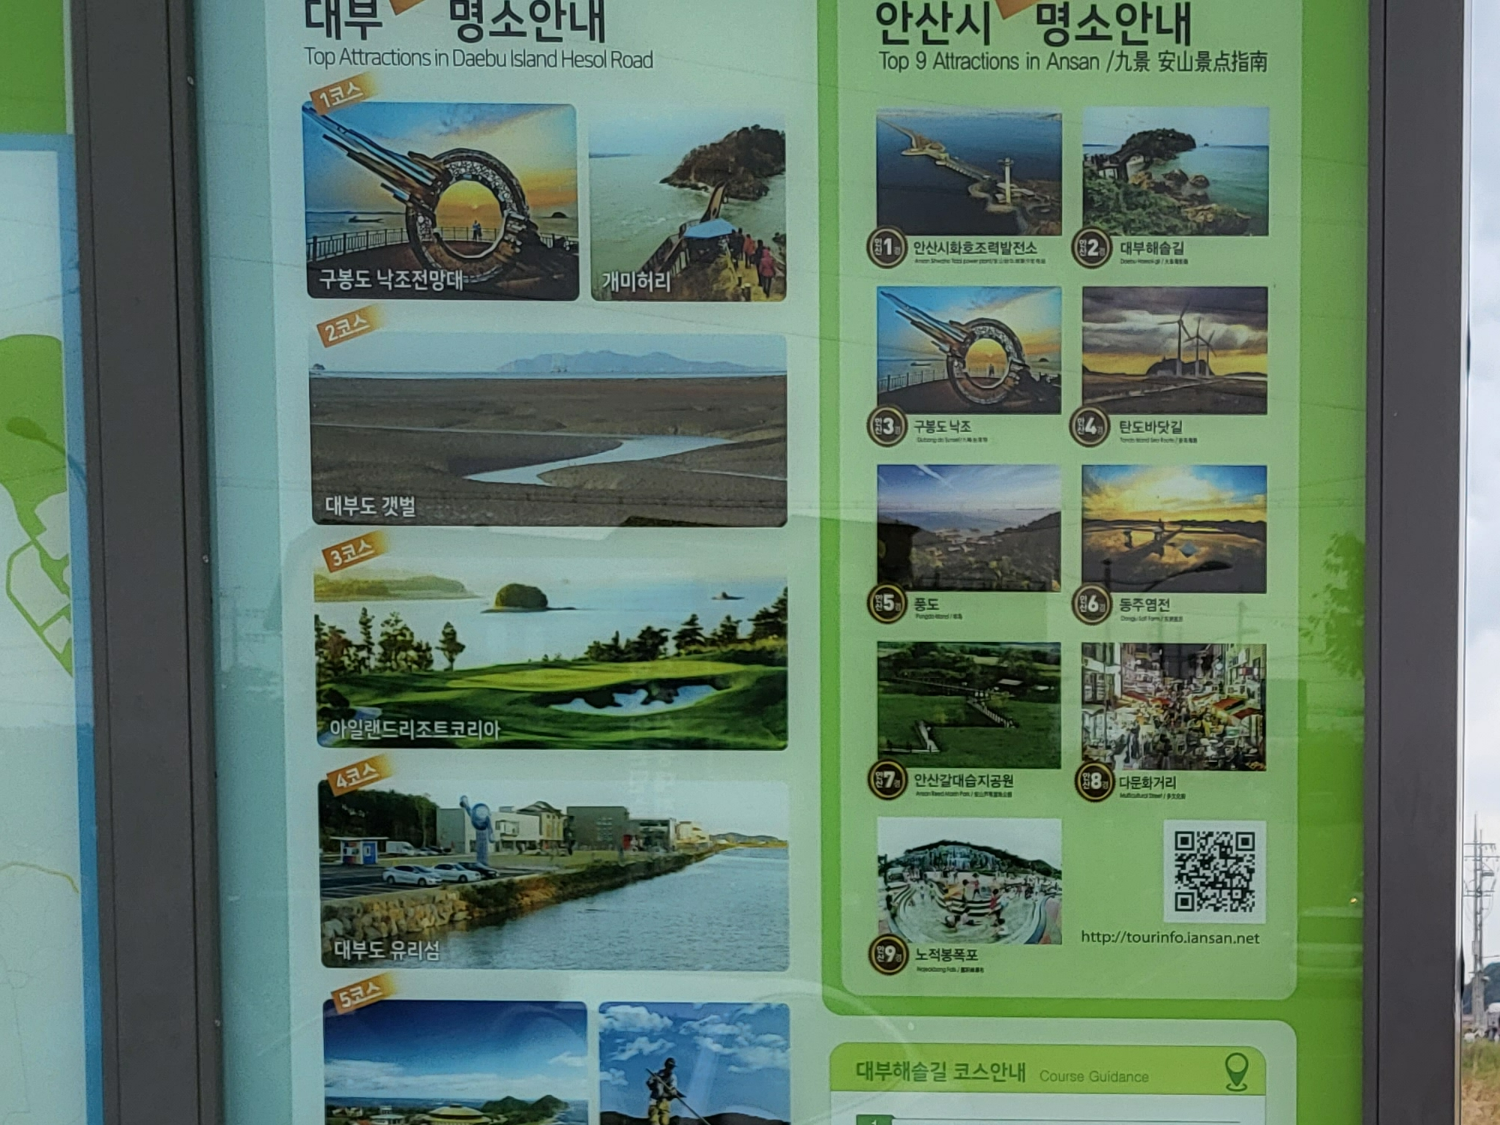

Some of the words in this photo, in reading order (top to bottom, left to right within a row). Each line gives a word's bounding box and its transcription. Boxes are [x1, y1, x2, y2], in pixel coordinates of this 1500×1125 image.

[305, 0, 382, 40] 대부
[449, 0, 606, 42] 명소안내
[876, 2, 991, 46] 안산시
[1036, 1, 1192, 47] 명소안내
[304, 47, 336, 68] Top
[339, 48, 431, 66] Attractions
[435, 48, 449, 66] in
[452, 50, 506, 68] Daebu
[511, 50, 558, 68] Island
[561, 50, 606, 69] Hesol
[610, 51, 653, 69] Road
[879, 51, 910, 72] Top
[916, 52, 927, 70] 9
[933, 52, 1019, 71] Attractions
[1026, 52, 1041, 71] in
[1045, 53, 1100, 71] Ansan
[1158, 50, 1268, 73] 安山景点指南
[318, 81, 363, 108] 1코스
[914, 241, 1037, 255] 안산시화호조력발전소
[1121, 241, 1184, 255] 대부해솔길
[319, 270, 372, 290] 구봉도
[376, 269, 464, 292] 낙조전망대
[602, 271, 671, 293] 개미허리
[325, 314, 370, 343] 2코스
[914, 420, 947, 433] 구봉도
[950, 420, 972, 433] 낙조
[1119, 420, 1183, 434] 탄도바닷길
[325, 496, 377, 517] 대부도
[382, 496, 416, 518] 갯벌
[330, 540, 375, 567] 3코스
[915, 597, 939, 611] 풍도
[1119, 598, 1170, 612] 동주염전
[330, 719, 501, 740] 아일랜드리조트코리아
[336, 762, 380, 790] 4코스
[915, 774, 1014, 788] 안산갈대습지공원
[1119, 775, 1177, 789] 다문화거리
[1081, 929, 1260, 946] http://tourinfo.iansan.net
[334, 941, 386, 961] 대부도
[390, 941, 440, 962] 유리섬
[915, 948, 978, 962] 노적봉폭포
[339, 980, 383, 1008] 5코스
[856, 1061, 947, 1083] 대부해솔길
[954, 1062, 1025, 1082] 코스안내
[1040, 1069, 1084, 1083] Course
[1089, 1069, 1149, 1084] Guidance
